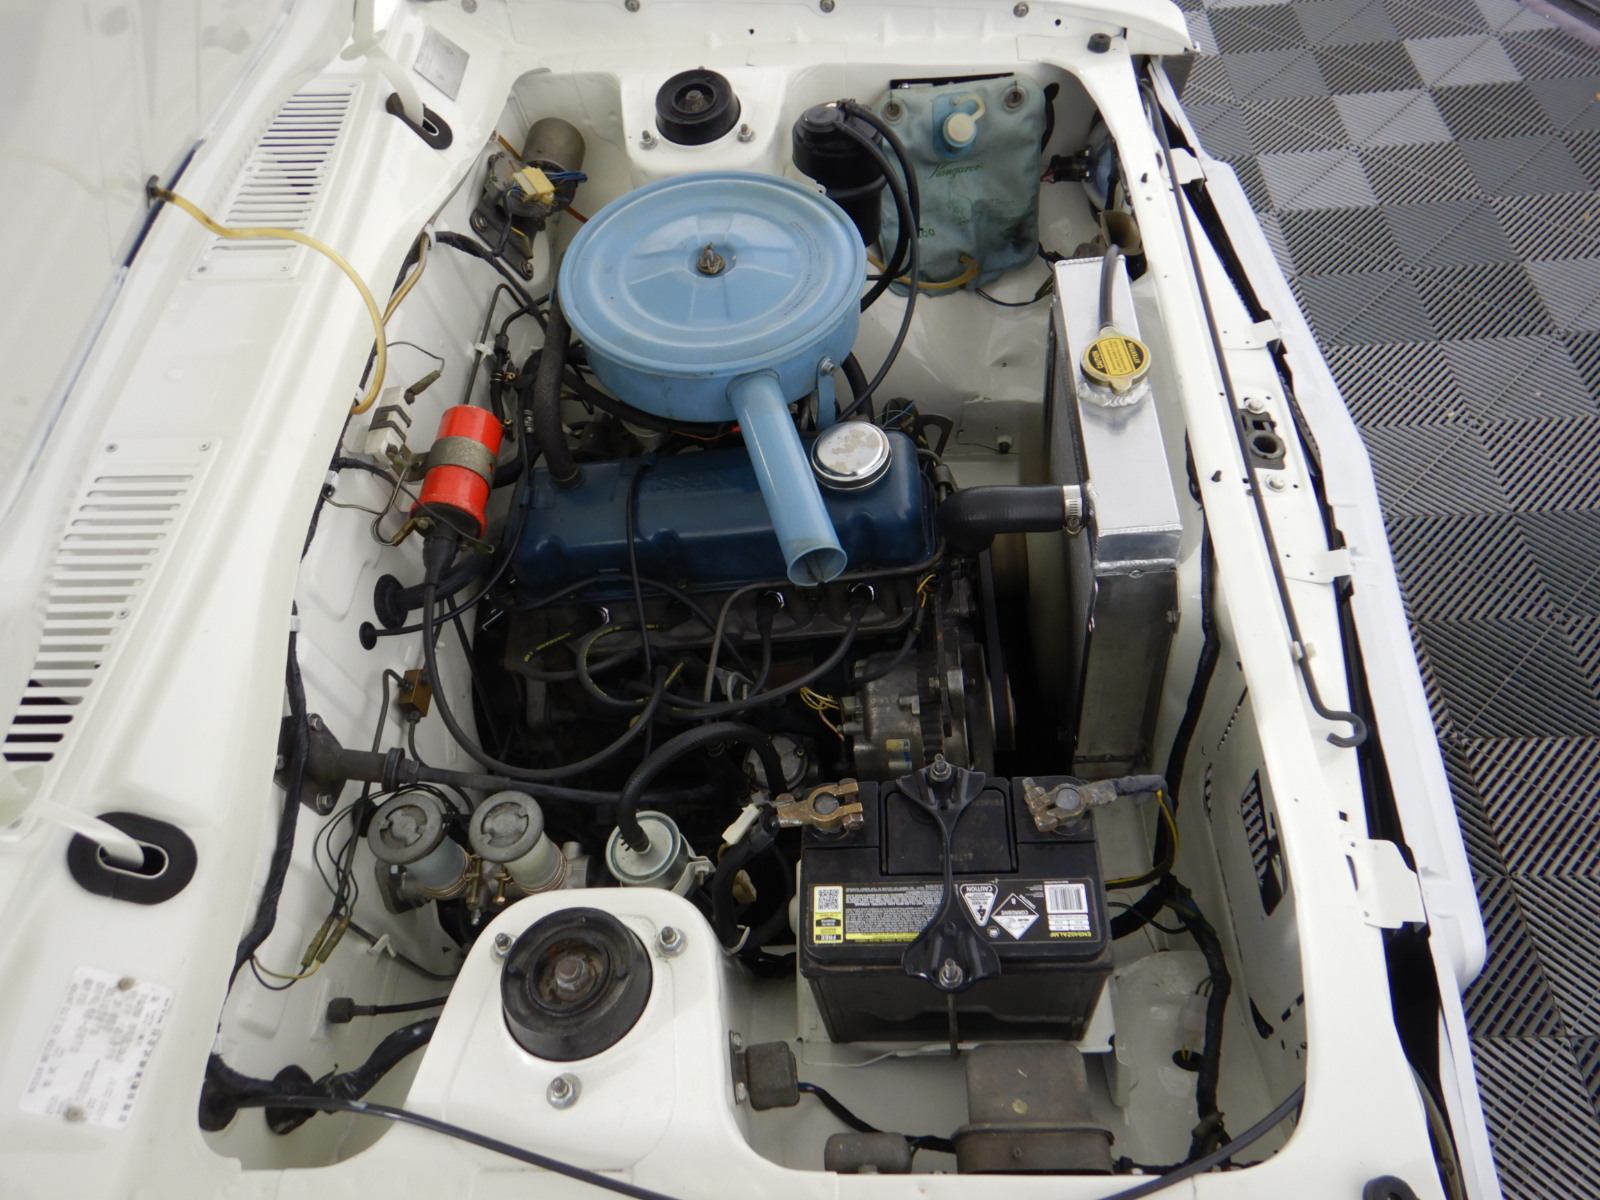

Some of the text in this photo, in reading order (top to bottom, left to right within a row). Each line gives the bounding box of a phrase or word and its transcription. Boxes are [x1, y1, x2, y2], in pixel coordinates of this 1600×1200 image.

[1091, 350, 1104, 370] CAUTION
[1128, 342, 1141, 364] ATTENTION
[966, 885, 993, 893] CAUTION
